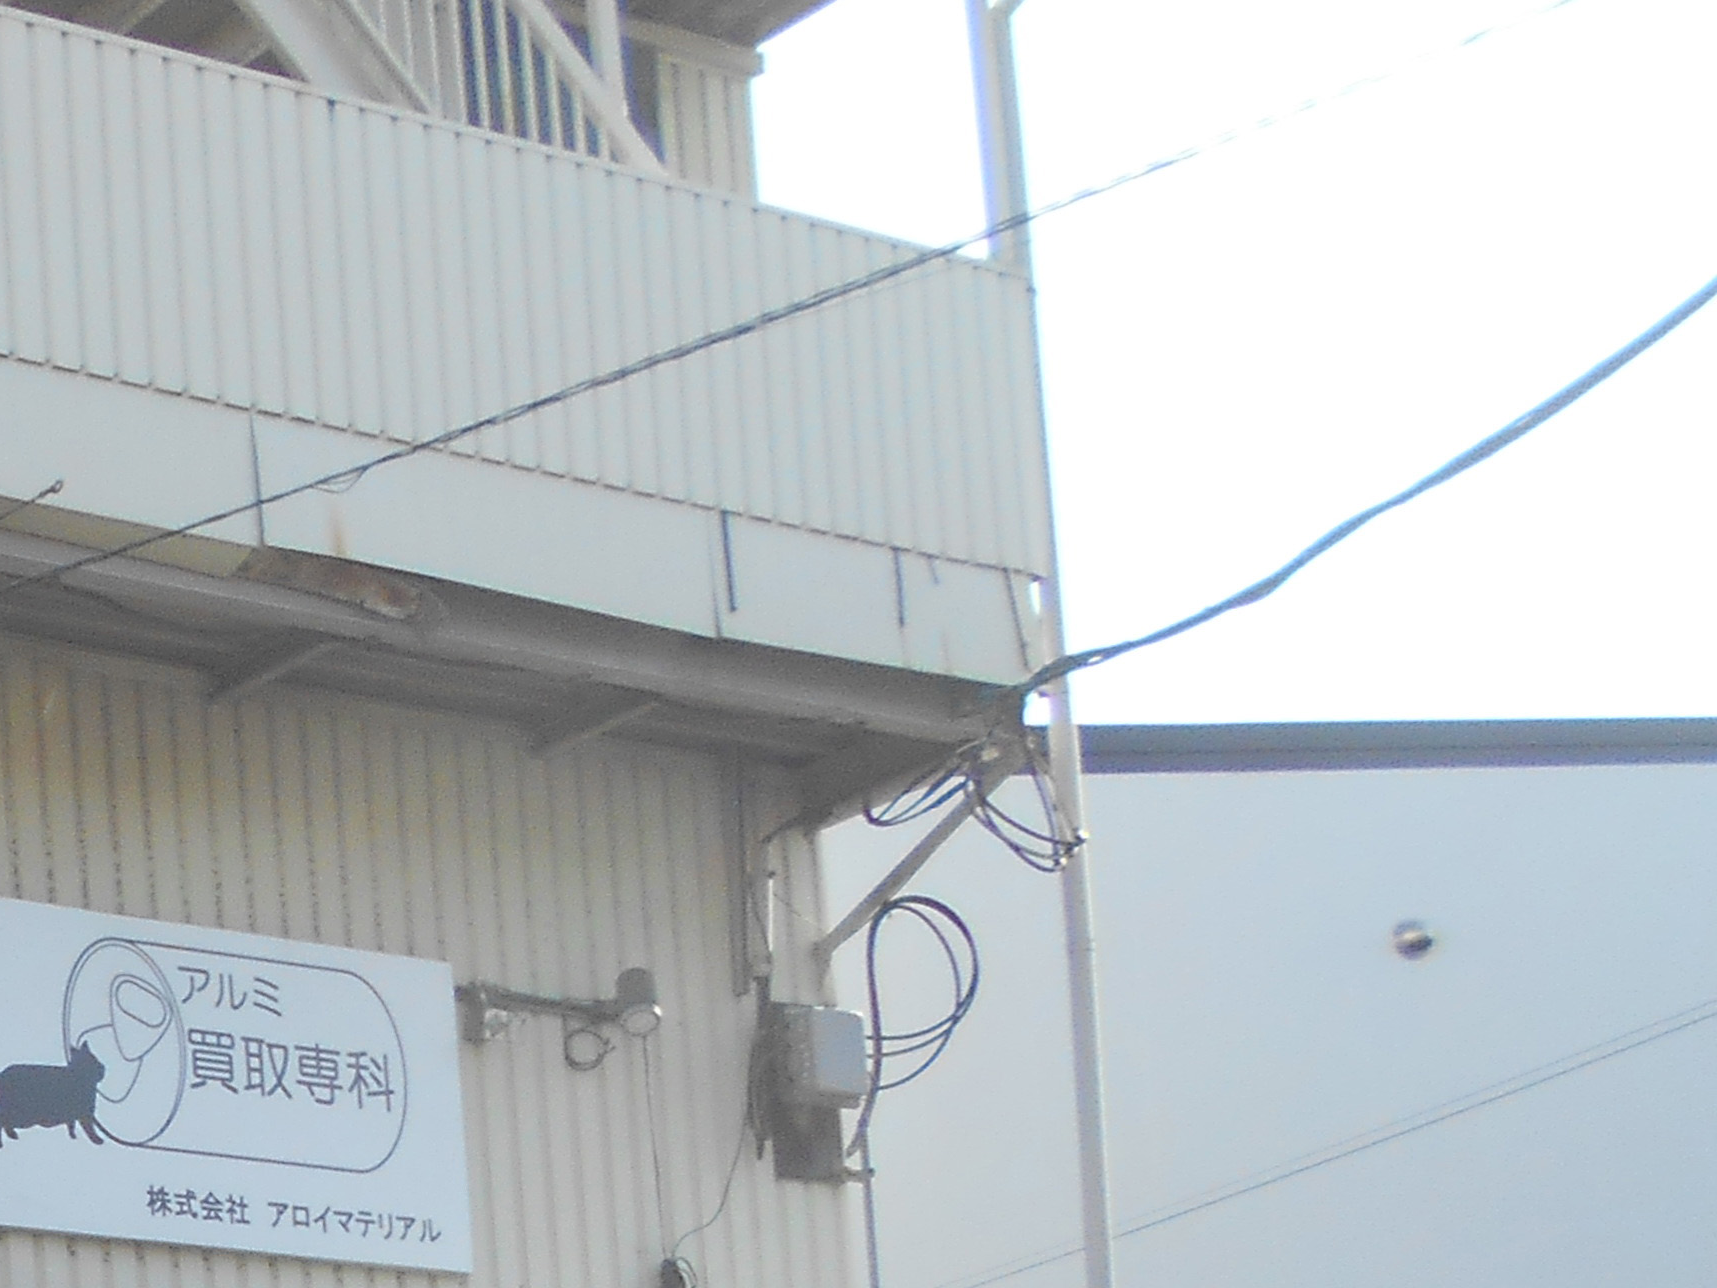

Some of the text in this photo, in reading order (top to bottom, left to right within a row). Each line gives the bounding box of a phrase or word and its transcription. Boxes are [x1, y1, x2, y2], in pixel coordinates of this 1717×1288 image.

[177, 965, 282, 1017] アルミ
[187, 1027, 395, 1113] 買取専科
[146, 1184, 442, 1243] 株式会社 アロイマテリアル
